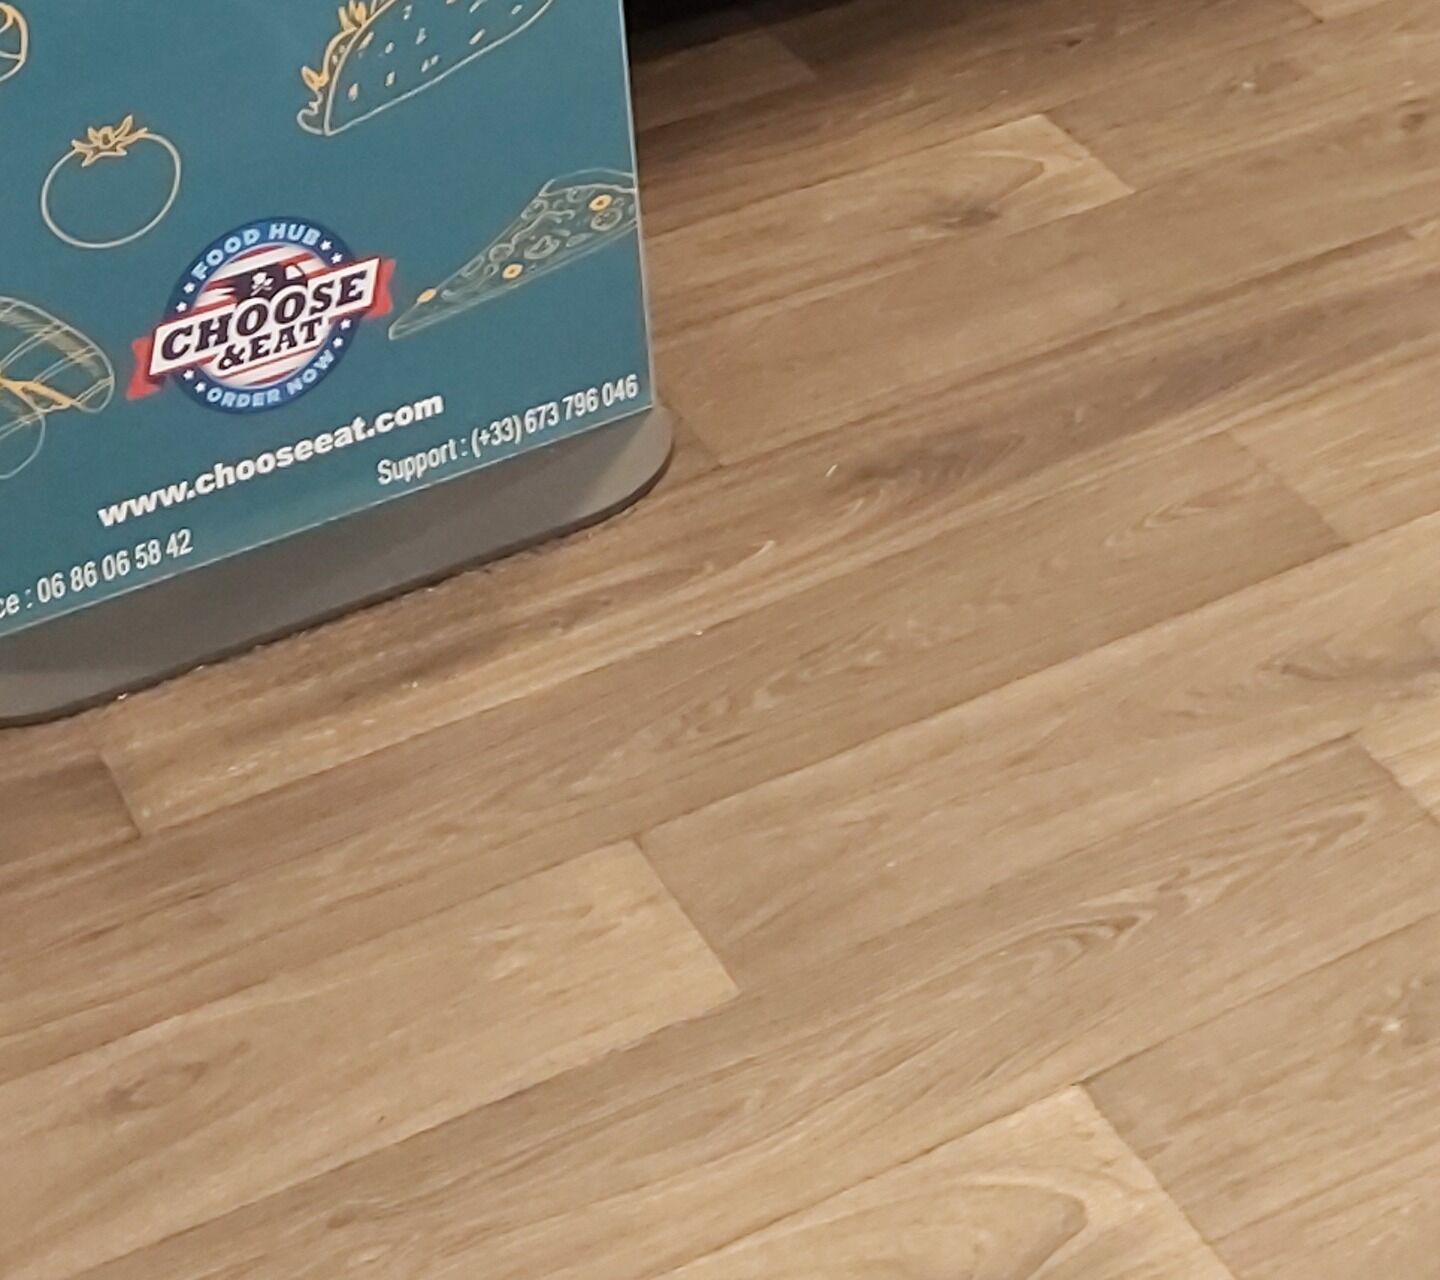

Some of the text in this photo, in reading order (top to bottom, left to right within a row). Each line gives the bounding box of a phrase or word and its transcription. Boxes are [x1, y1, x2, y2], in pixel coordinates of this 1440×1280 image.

[190, 223, 322, 281] FOOD HUB
[160, 269, 368, 362] CHOOSE
[217, 317, 323, 371] &EAT
[206, 348, 336, 409] ORDER NOW
[97, 393, 445, 529] www.chooseeat.com
[376, 438, 458, 486] Support
[471, 414, 523, 458] (+33)
[524, 402, 560, 434] 673
[562, 387, 600, 421] 796
[601, 373, 640, 407] 046
[36, 571, 67, 604] 06
[70, 560, 99, 593] 86
[102, 549, 131, 582] 06
[135, 538, 162, 570] 58
[165, 527, 194, 559] 42
